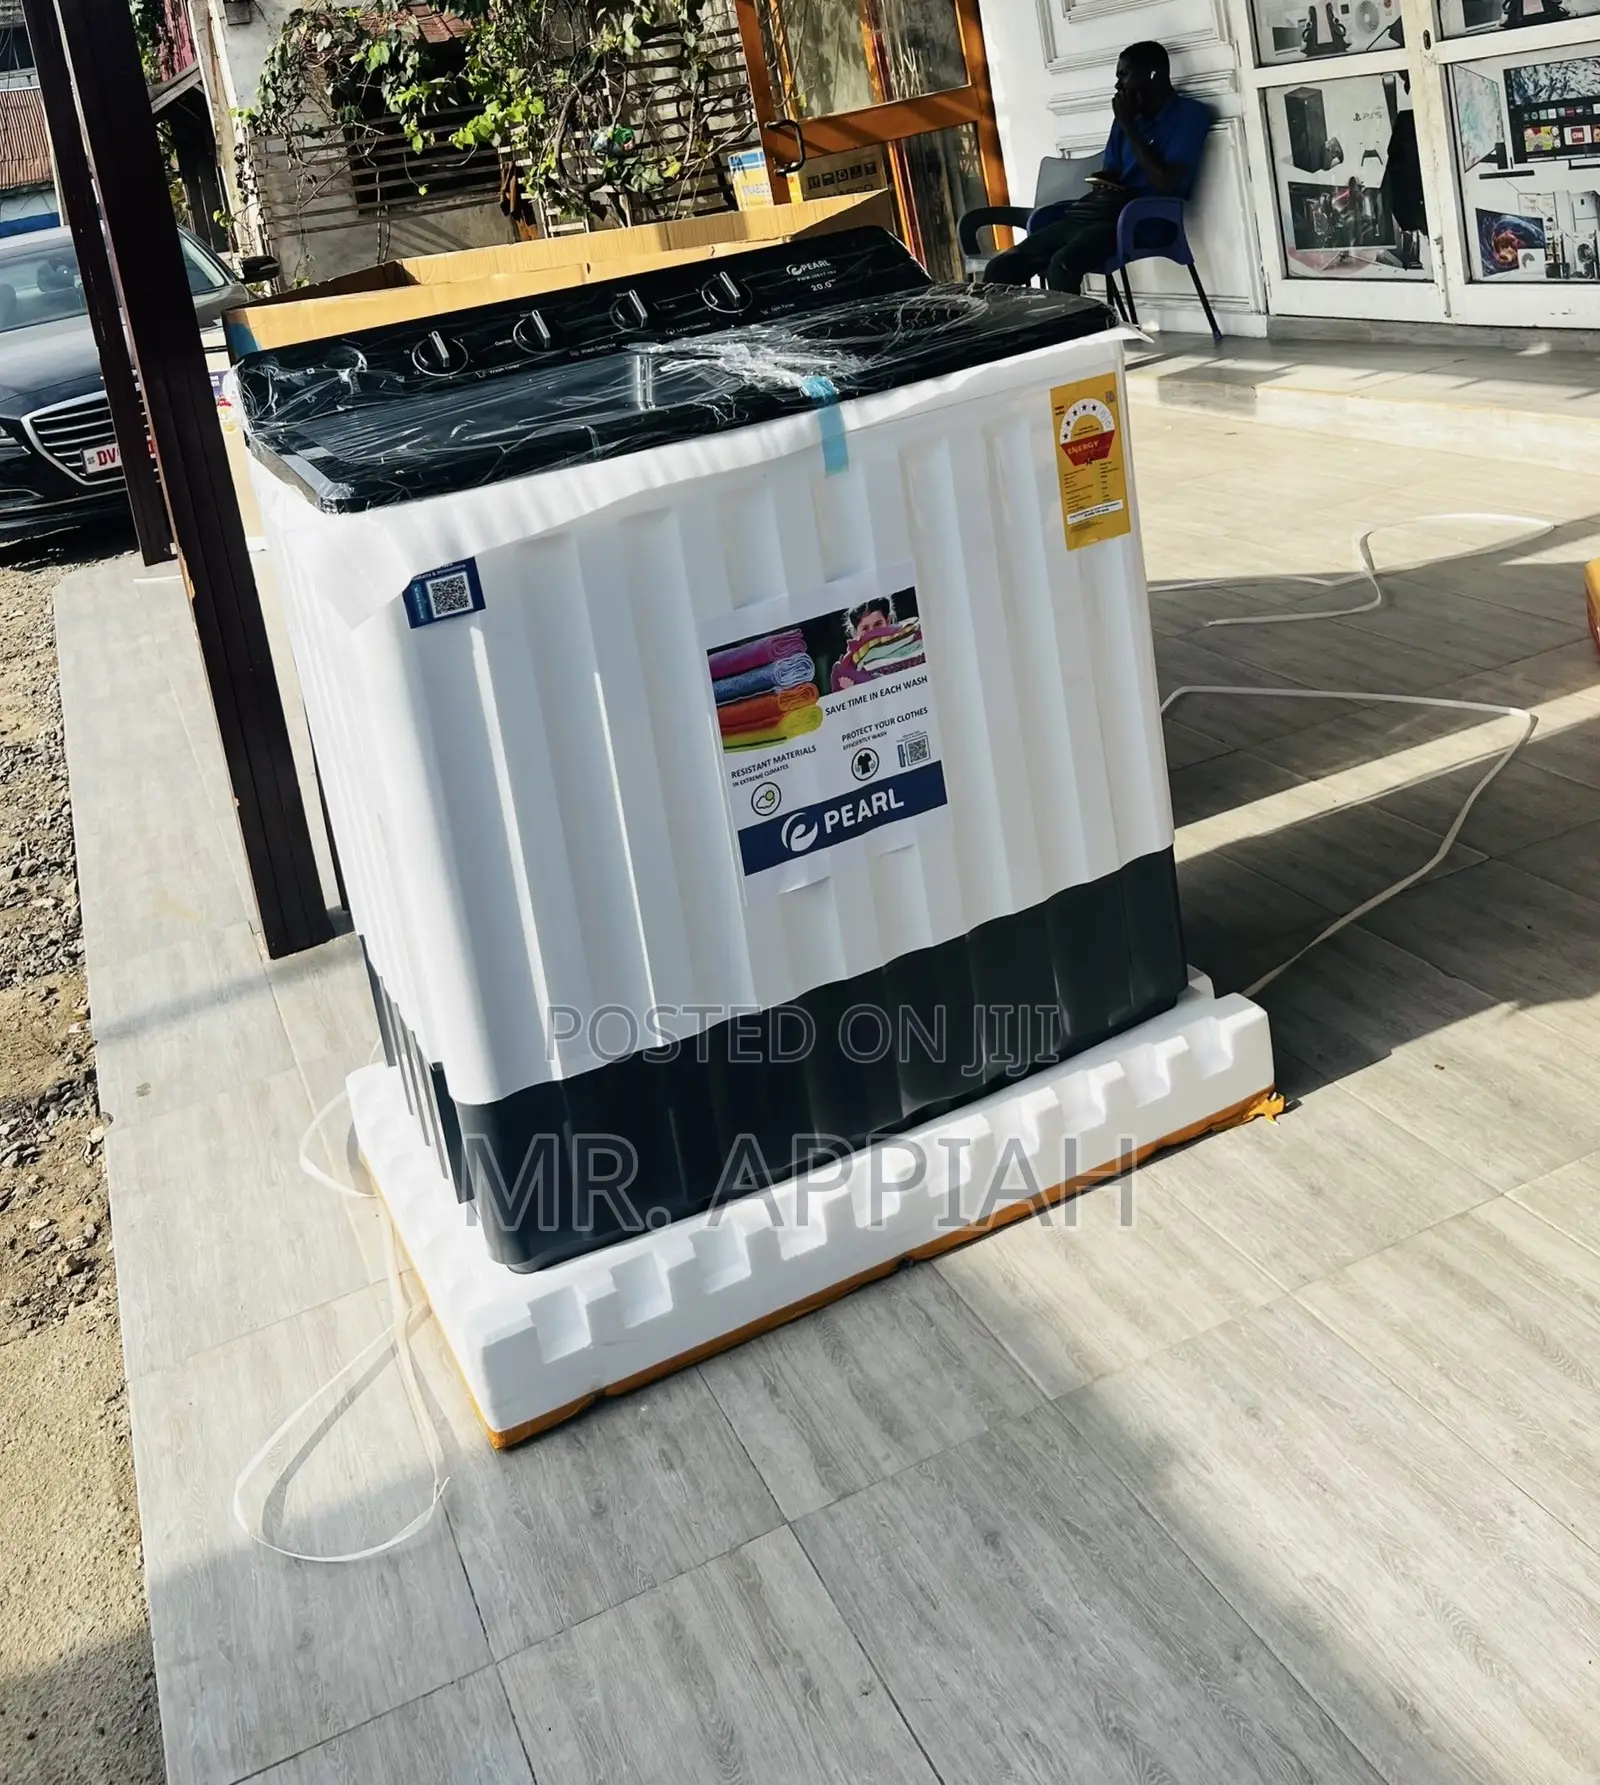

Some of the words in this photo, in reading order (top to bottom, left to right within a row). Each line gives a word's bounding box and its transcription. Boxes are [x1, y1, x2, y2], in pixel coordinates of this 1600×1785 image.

[801, 260, 832, 272] PEARL
[96, 447, 116, 467] DV
[1067, 440, 1100, 455] ENERGY
[825, 702, 847, 716] SAVE
[848, 694, 868, 709] TIME
[869, 691, 879, 701] IN
[879, 683, 902, 698] EACH
[902, 675, 929, 690] WASH
[841, 724, 873, 742] PROTECT
[874, 718, 896, 730] YOUR
[896, 706, 929, 723] CLOTHES
[871, 731, 888, 741] WASH
[731, 758, 771, 779] RESISTANT
[772, 744, 817, 764] MATERIALS
[732, 780, 740, 788] IN
[740, 772, 764, 786] EXTREME
[764, 764, 789, 777] CLIMATES
[823, 788, 905, 834] PEARL
